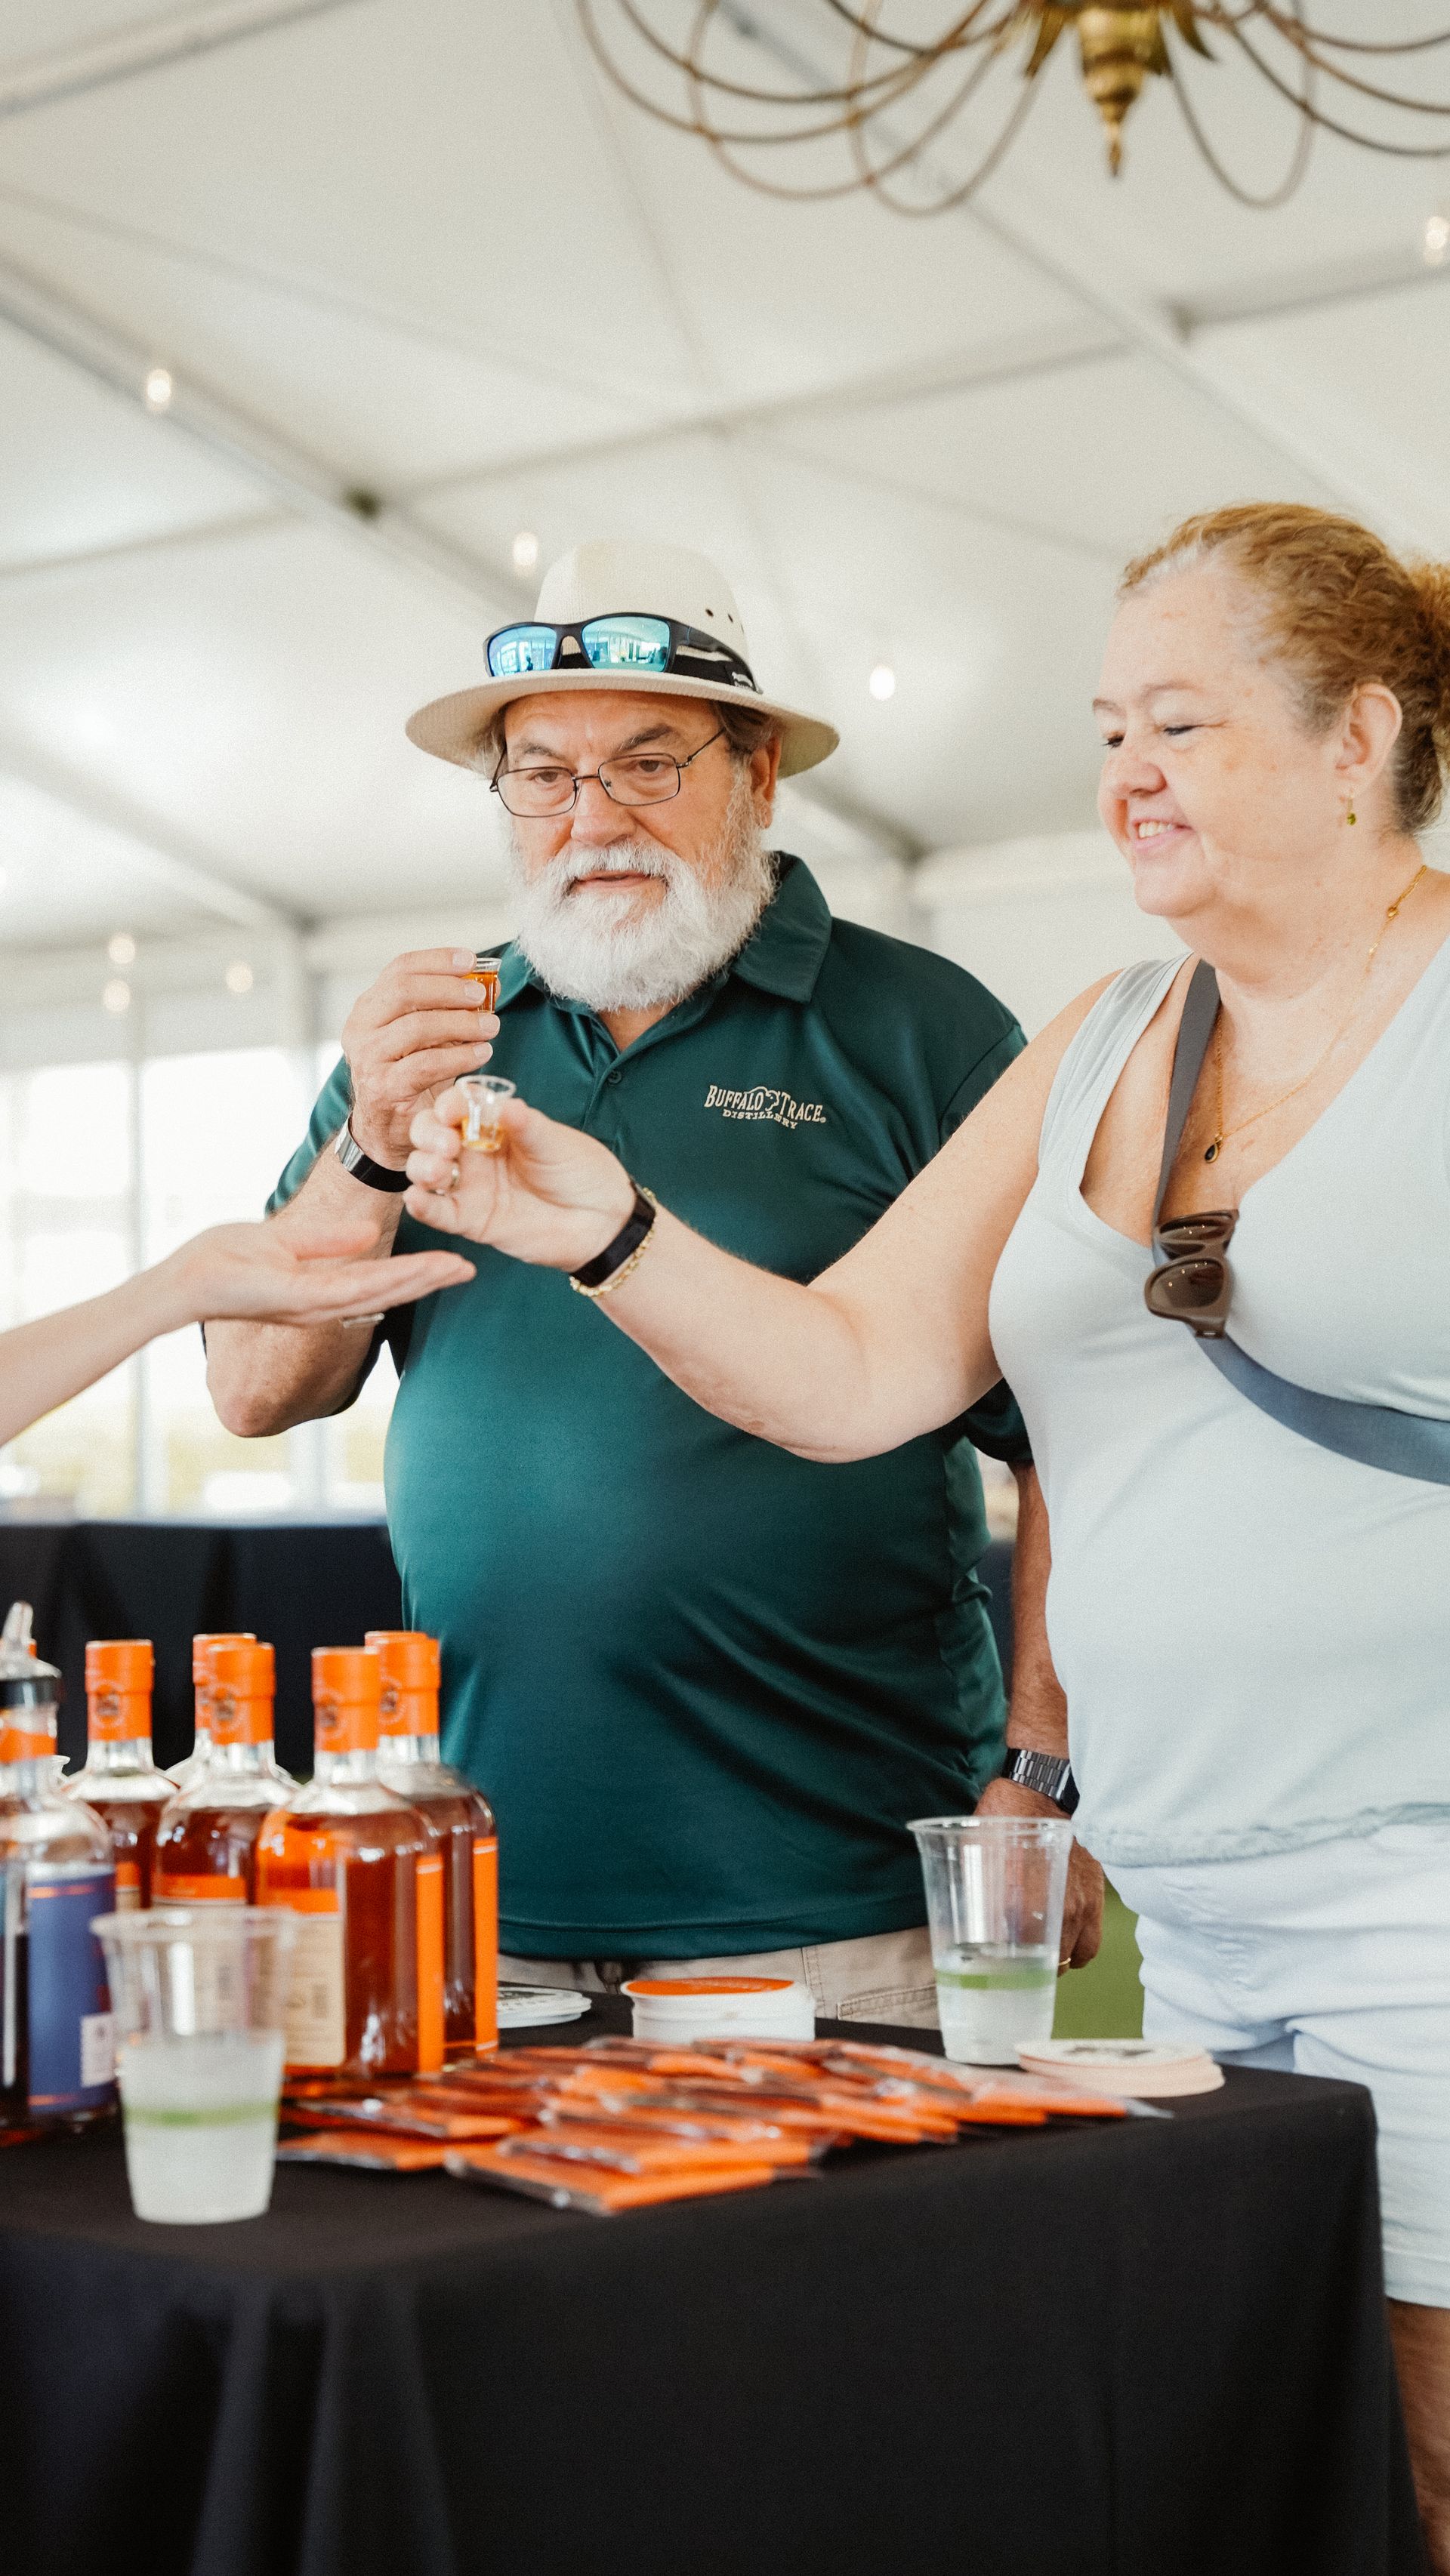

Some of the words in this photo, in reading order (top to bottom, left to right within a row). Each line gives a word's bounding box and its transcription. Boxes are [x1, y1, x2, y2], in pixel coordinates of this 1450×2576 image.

[704, 1085, 764, 1111] BUFFALO
[779, 1092, 823, 1123] TRACE
[722, 1108, 798, 1129] DISTILLERY
